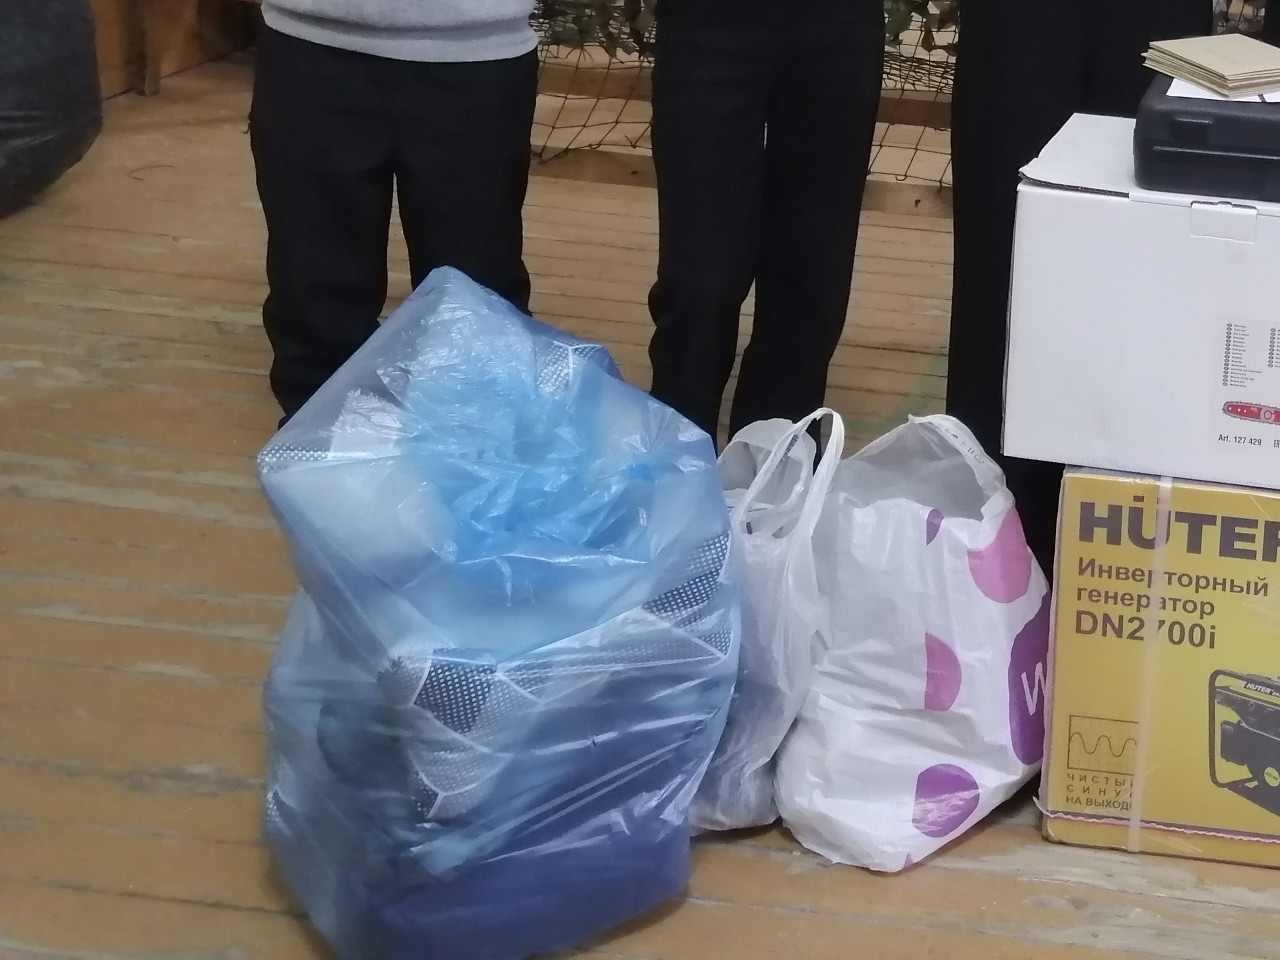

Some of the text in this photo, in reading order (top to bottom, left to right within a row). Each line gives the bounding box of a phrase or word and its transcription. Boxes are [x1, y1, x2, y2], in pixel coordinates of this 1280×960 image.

[1234, 436, 1246, 444] 127
[1249, 438, 1262, 446] 429
[1067, 773, 1133, 787] ЧИСТЫ
[1066, 795, 1132, 811] НА ВЫХОД
